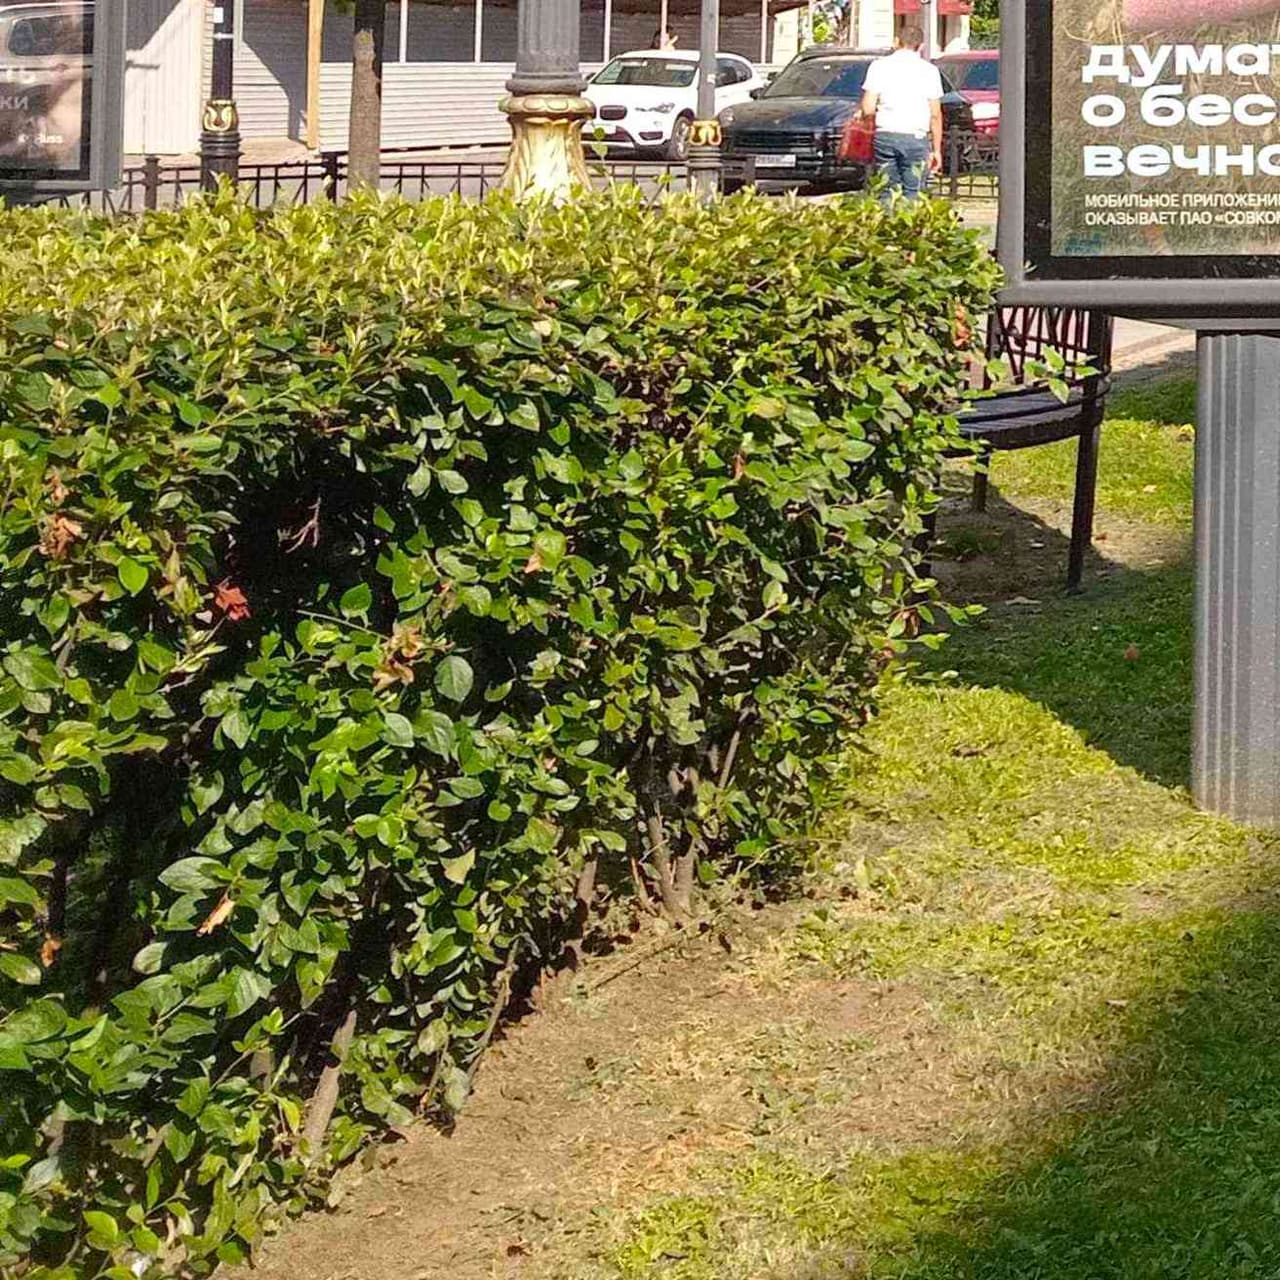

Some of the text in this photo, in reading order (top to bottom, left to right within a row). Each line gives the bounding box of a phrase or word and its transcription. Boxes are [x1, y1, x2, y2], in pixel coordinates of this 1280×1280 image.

[1081, 93, 1126, 127] о
[1084, 193, 1180, 208] МОБИЛЬНОЕ
[1084, 211, 1178, 226] ОКАЗЫВАЕТ
[1180, 211, 1213, 225] ПАО
